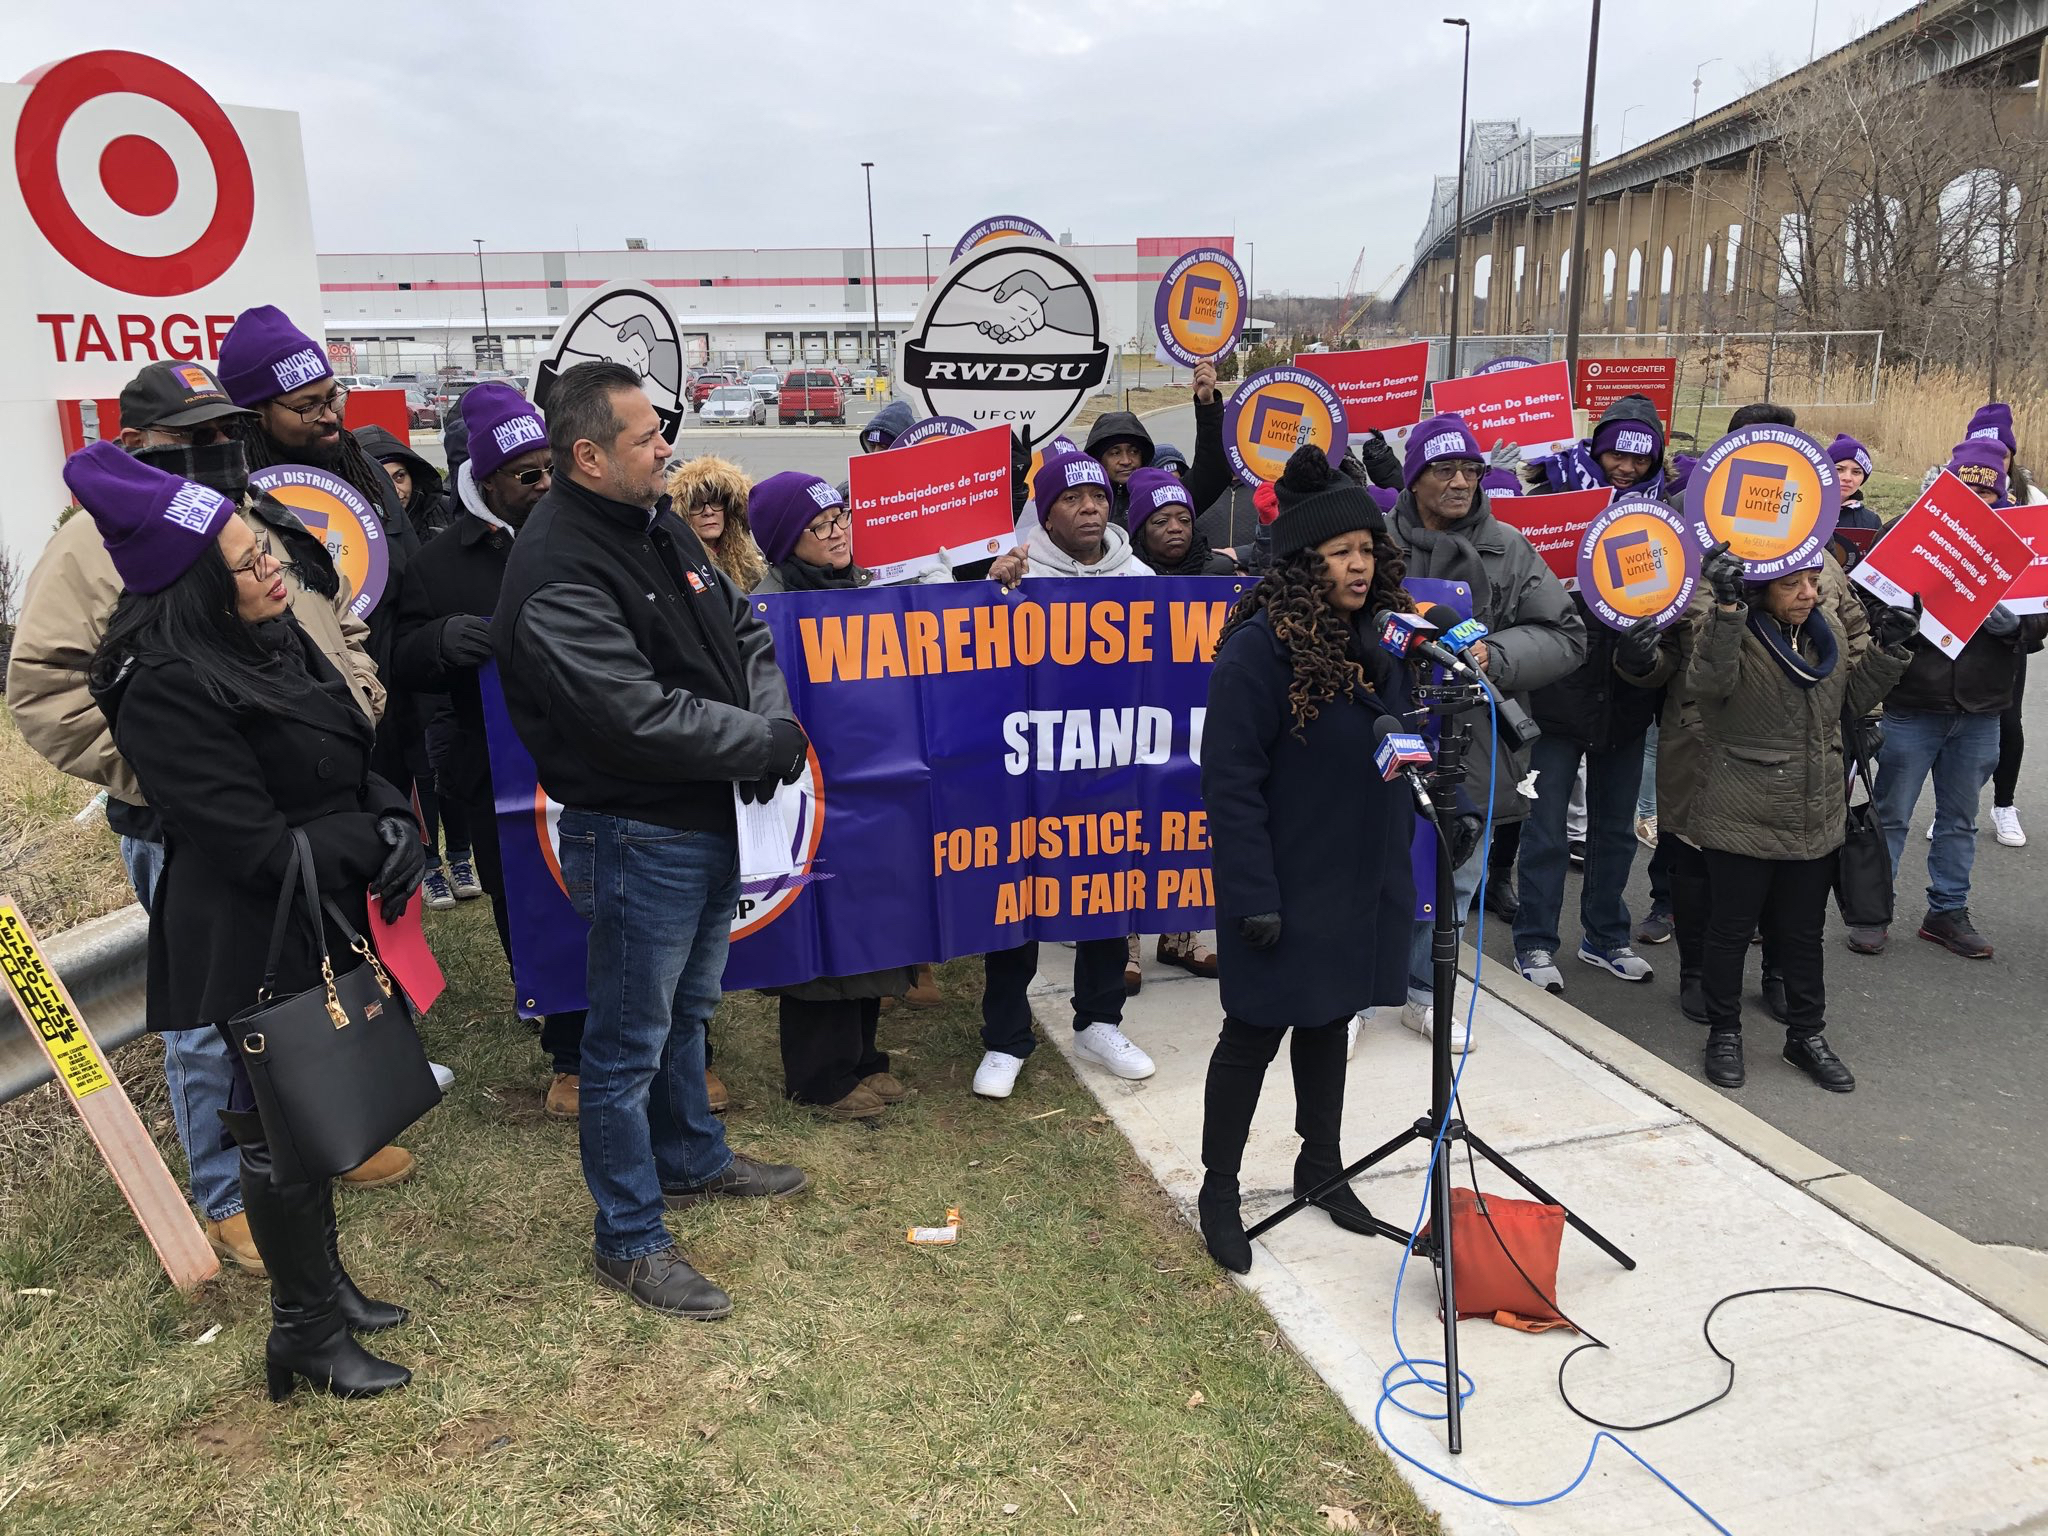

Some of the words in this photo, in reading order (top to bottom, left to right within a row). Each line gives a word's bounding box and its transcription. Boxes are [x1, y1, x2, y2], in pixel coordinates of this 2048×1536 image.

[1167, 253, 1199, 286] LAUNDRY,
[1199, 252, 1241, 281] DISTRIBUTION
[1236, 279, 1245, 297] AND
[1195, 306, 1222, 318] united
[1197, 296, 1229, 310] workers
[36, 313, 235, 362] TARGE
[1161, 323, 1174, 345] FOOD
[272, 348, 319, 376] UNIONS
[925, 361, 1090, 382] RWDSU
[1631, 365, 1665, 373] CENTER
[279, 370, 302, 387] FOR
[303, 362, 326, 380] ALL
[1338, 380, 1381, 391] Workers
[1383, 374, 1419, 387] Deserve
[1235, 373, 1274, 406] LAUNDRY,
[1274, 371, 1333, 404] DISTRIBUTION
[1328, 402, 1342, 424] AND
[1340, 394, 1384, 405] rievance
[1385, 388, 1418, 400] Process
[1478, 403, 1501, 413] Can
[1505, 399, 1522, 409] Do
[1525, 392, 1565, 406] Better.
[973, 410, 1036, 420] UFCW
[1482, 418, 1516, 429] Make
[1518, 410, 1555, 425] Them.
[492, 415, 537, 440] UNIONS
[498, 432, 519, 449] FOR
[520, 426, 543, 442] ALL
[904, 421, 948, 447] LAUNDRY,
[1267, 429, 1305, 445] united
[1271, 419, 1317, 436] workers
[1618, 430, 1653, 444] UNIONS
[1424, 431, 1463, 450] UNIONS
[1425, 445, 1440, 457] FOR
[1444, 441, 1465, 452] ALL
[1616, 440, 1632, 450] FOR
[1633, 443, 1650, 454] ALL
[1064, 461, 1101, 474] UNIONS
[1229, 446, 1244, 470] FOOD
[1702, 434, 1750, 473] LAUNDRY,
[1752, 429, 1823, 465] DISTRIBUTION
[1816, 463, 1833, 487] AND
[1067, 471, 1084, 483] FOR
[1087, 471, 1103, 482] ALL
[815, 492, 831, 505] FOR
[855, 498, 877, 510] Los
[880, 480, 955, 506] trabajadores
[958, 476, 971, 488] de
[973, 466, 1006, 483] Target
[1151, 485, 1184, 499] UNIONS
[1485, 487, 1515, 497] UNIONS
[1749, 486, 1803, 503] workers
[163, 481, 202, 524] UNIONS
[283, 471, 364, 518] DISTRIBUTION
[360, 514, 379, 540] AND
[866, 509, 918, 527] merecen
[921, 498, 967, 517] horarios
[969, 487, 999, 507] justos
[1154, 493, 1169, 505] FOR
[1745, 498, 1790, 515] united
[183, 506, 208, 530] FOR
[198, 490, 224, 511] ALL
[1521, 523, 1563, 536] Workers
[1582, 516, 1612, 560] LAUNDRY,
[1608, 502, 1670, 520] DISTRIBUTION
[1667, 515, 1685, 535] AND
[1694, 521, 1714, 549] FOOD
[1754, 560, 1784, 574] JOINT
[1788, 535, 1820, 566] BOARD
[1923, 498, 1941, 517] Los
[1940, 511, 1986, 556] trabajadores
[1982, 551, 1993, 564] de
[1990, 558, 2013, 583] Target
[1625, 546, 1668, 565] workers
[1928, 529, 1962, 563] merecen
[1960, 557, 1984, 580] cuotas
[1977, 573, 1988, 587] de
[1627, 559, 1662, 576] united
[1912, 543, 1955, 582] producción
[1952, 576, 1977, 603] seguras
[1595, 600, 1618, 621] FOOD
[1655, 604, 1678, 625] JOINT
[1675, 577, 1694, 609] BOARD
[799, 600, 1155, 684] WAREHOUSE
[1384, 623, 1396, 641] FOX
[1392, 628, 1405, 645] 5
[1002, 705, 1173, 776] STAND
[1392, 738, 1425, 750] WMBC
[1376, 741, 1393, 769] WMBC
[934, 825, 998, 877] FOR
[1006, 810, 1151, 864] JUSTICE,
[994, 875, 1060, 926] AND
[1070, 868, 1147, 916] FAIR
[0, 914, 75, 1044] ETROLEUM
[5, 916, 79, 1033] PIPELINE
